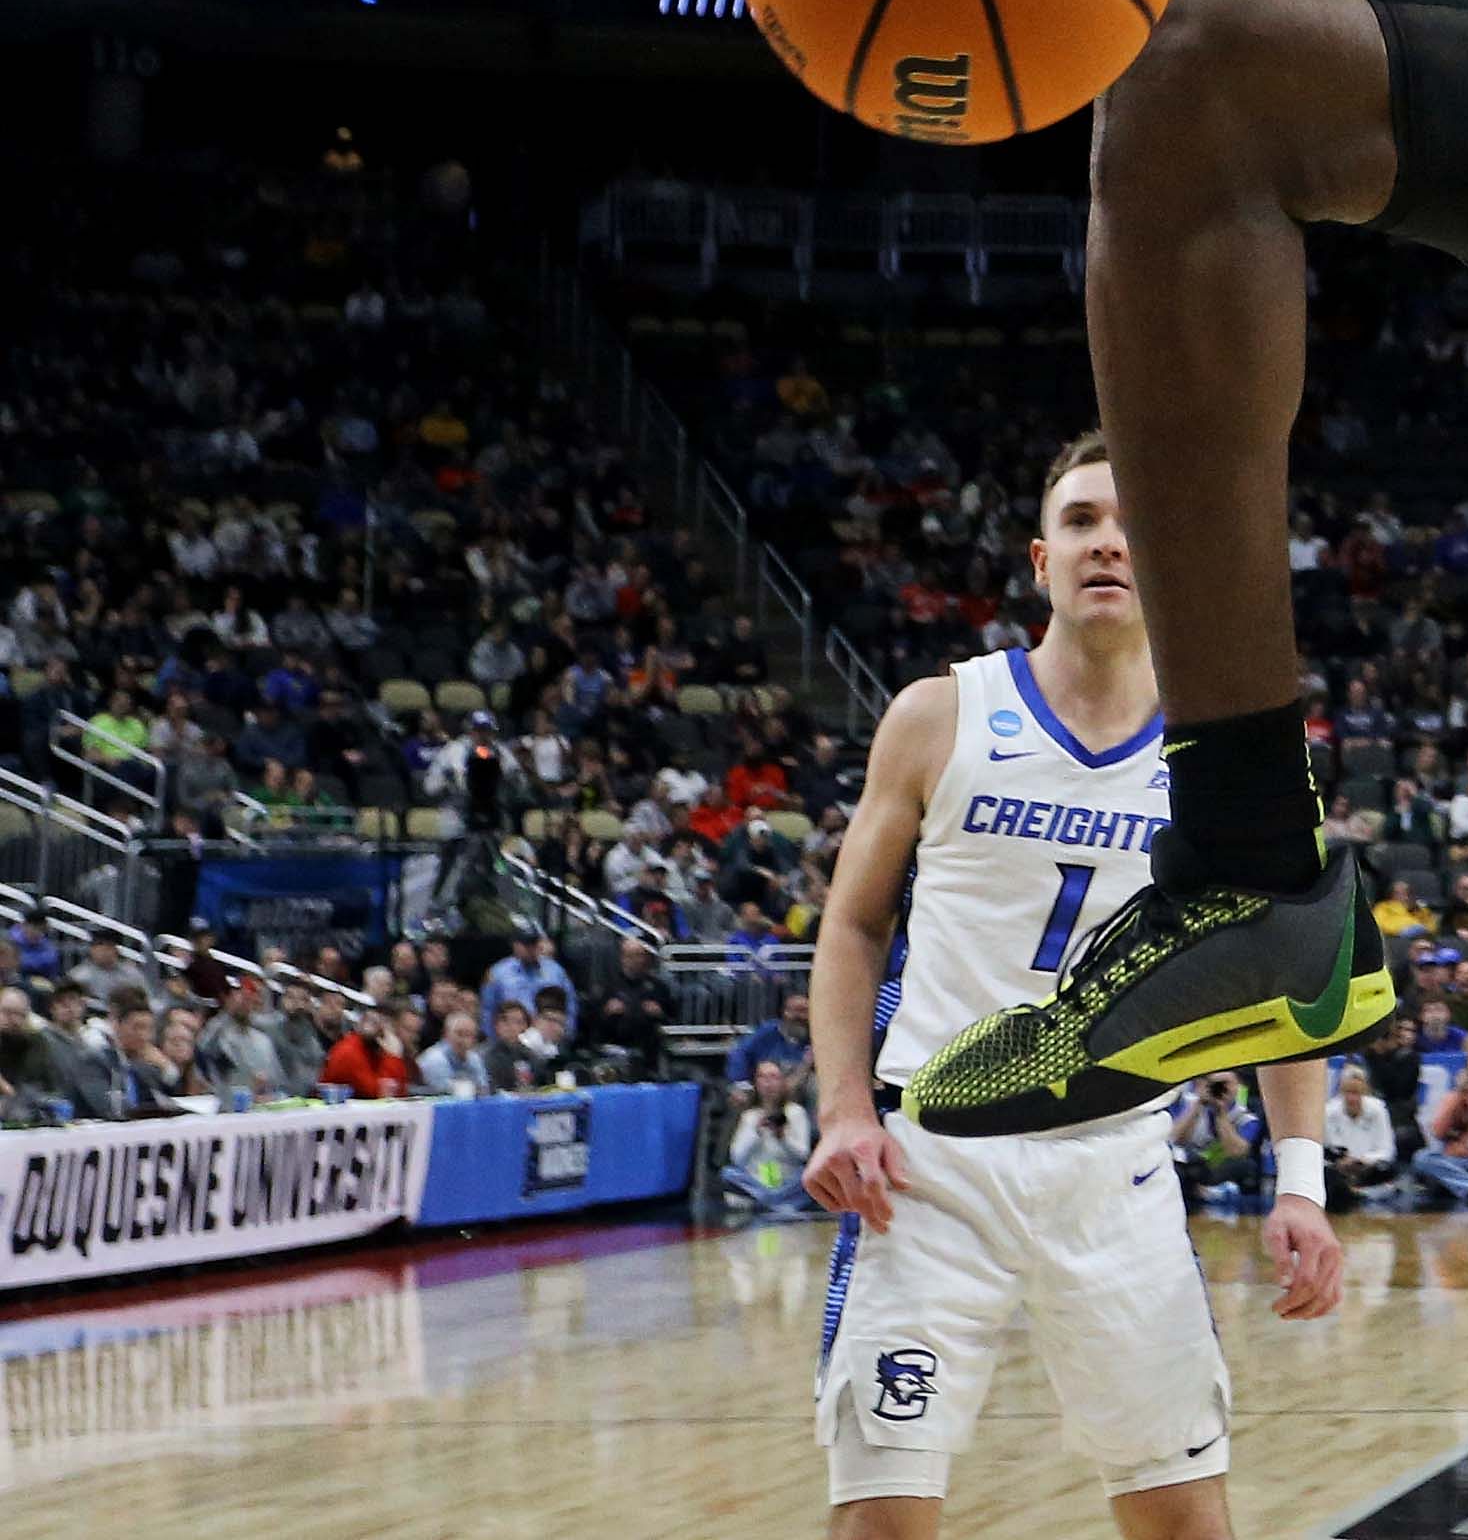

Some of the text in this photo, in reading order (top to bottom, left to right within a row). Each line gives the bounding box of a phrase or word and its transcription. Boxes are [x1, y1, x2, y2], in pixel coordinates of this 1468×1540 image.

[1031, 862, 1096, 973] 1
[12, 1138, 223, 1257] DUQUESNE
[231, 1120, 418, 1227] UNIVERSITY
